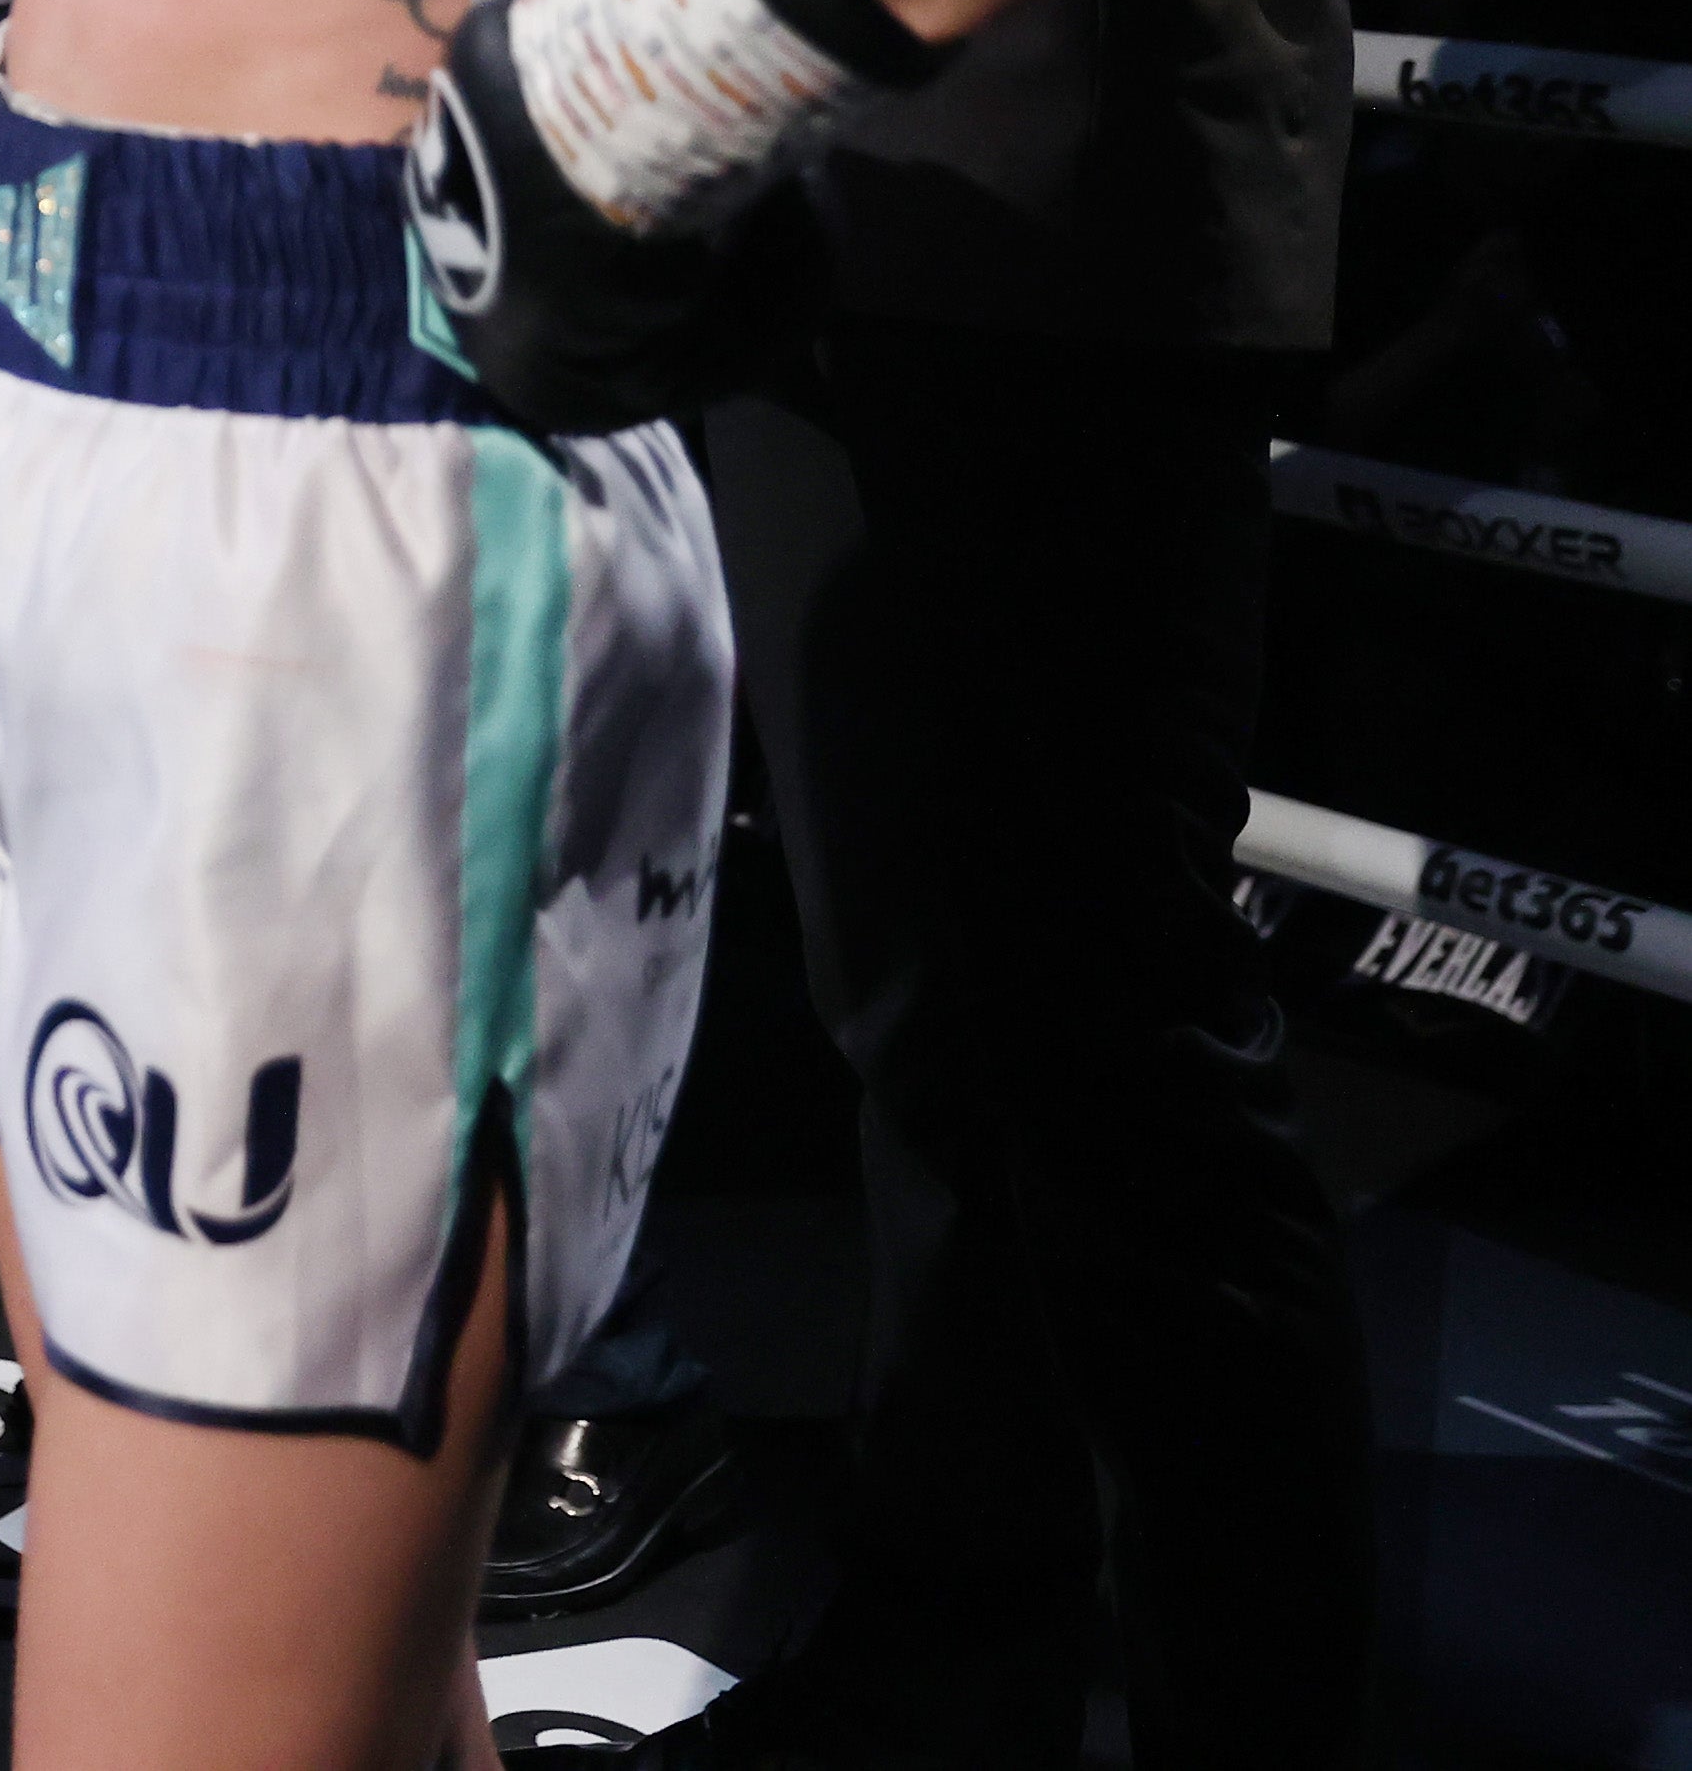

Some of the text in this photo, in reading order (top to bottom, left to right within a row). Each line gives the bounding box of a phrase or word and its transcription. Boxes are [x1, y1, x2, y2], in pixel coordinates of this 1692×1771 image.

[1398, 58, 1613, 128] bet365
[1418, 843, 1650, 952] bet365
[1352, 909, 1546, 1029] EVERLA
